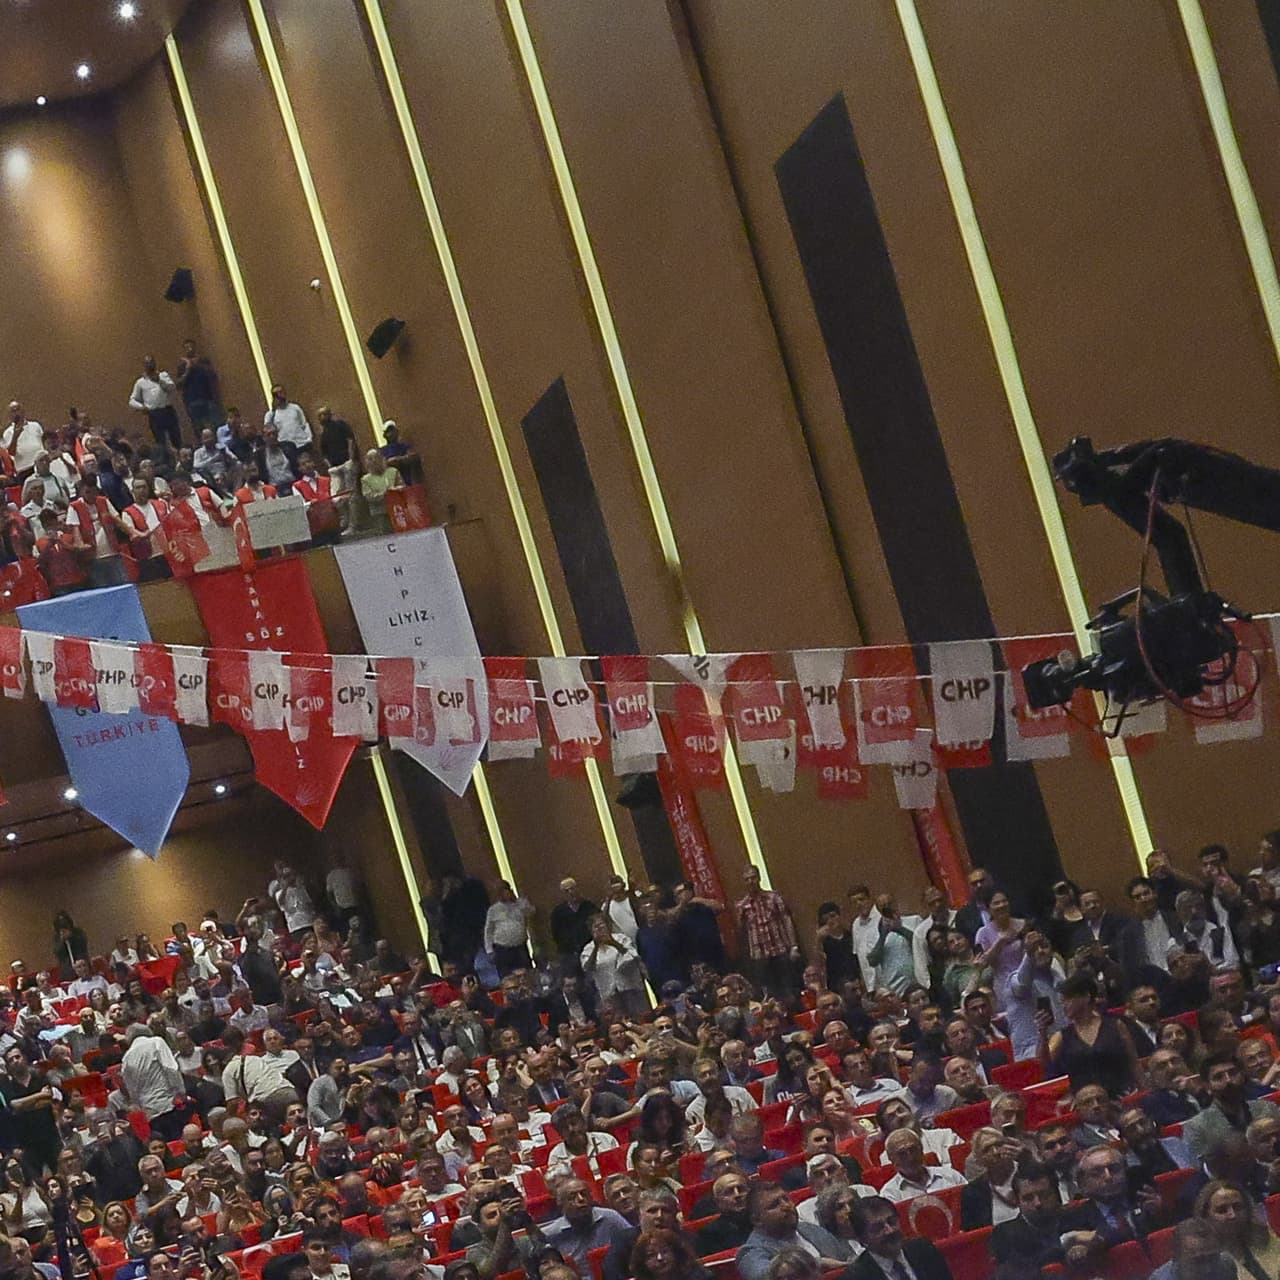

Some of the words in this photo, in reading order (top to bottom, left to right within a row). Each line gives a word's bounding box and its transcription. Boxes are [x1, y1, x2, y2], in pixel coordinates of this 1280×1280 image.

[552, 689, 589, 707] CHP
[941, 678, 990, 701] CHP
[616, 694, 648, 714] CHP
[494, 706, 532, 726] CHP
[740, 706, 782, 726] CHP
[871, 705, 912, 727] CHP
